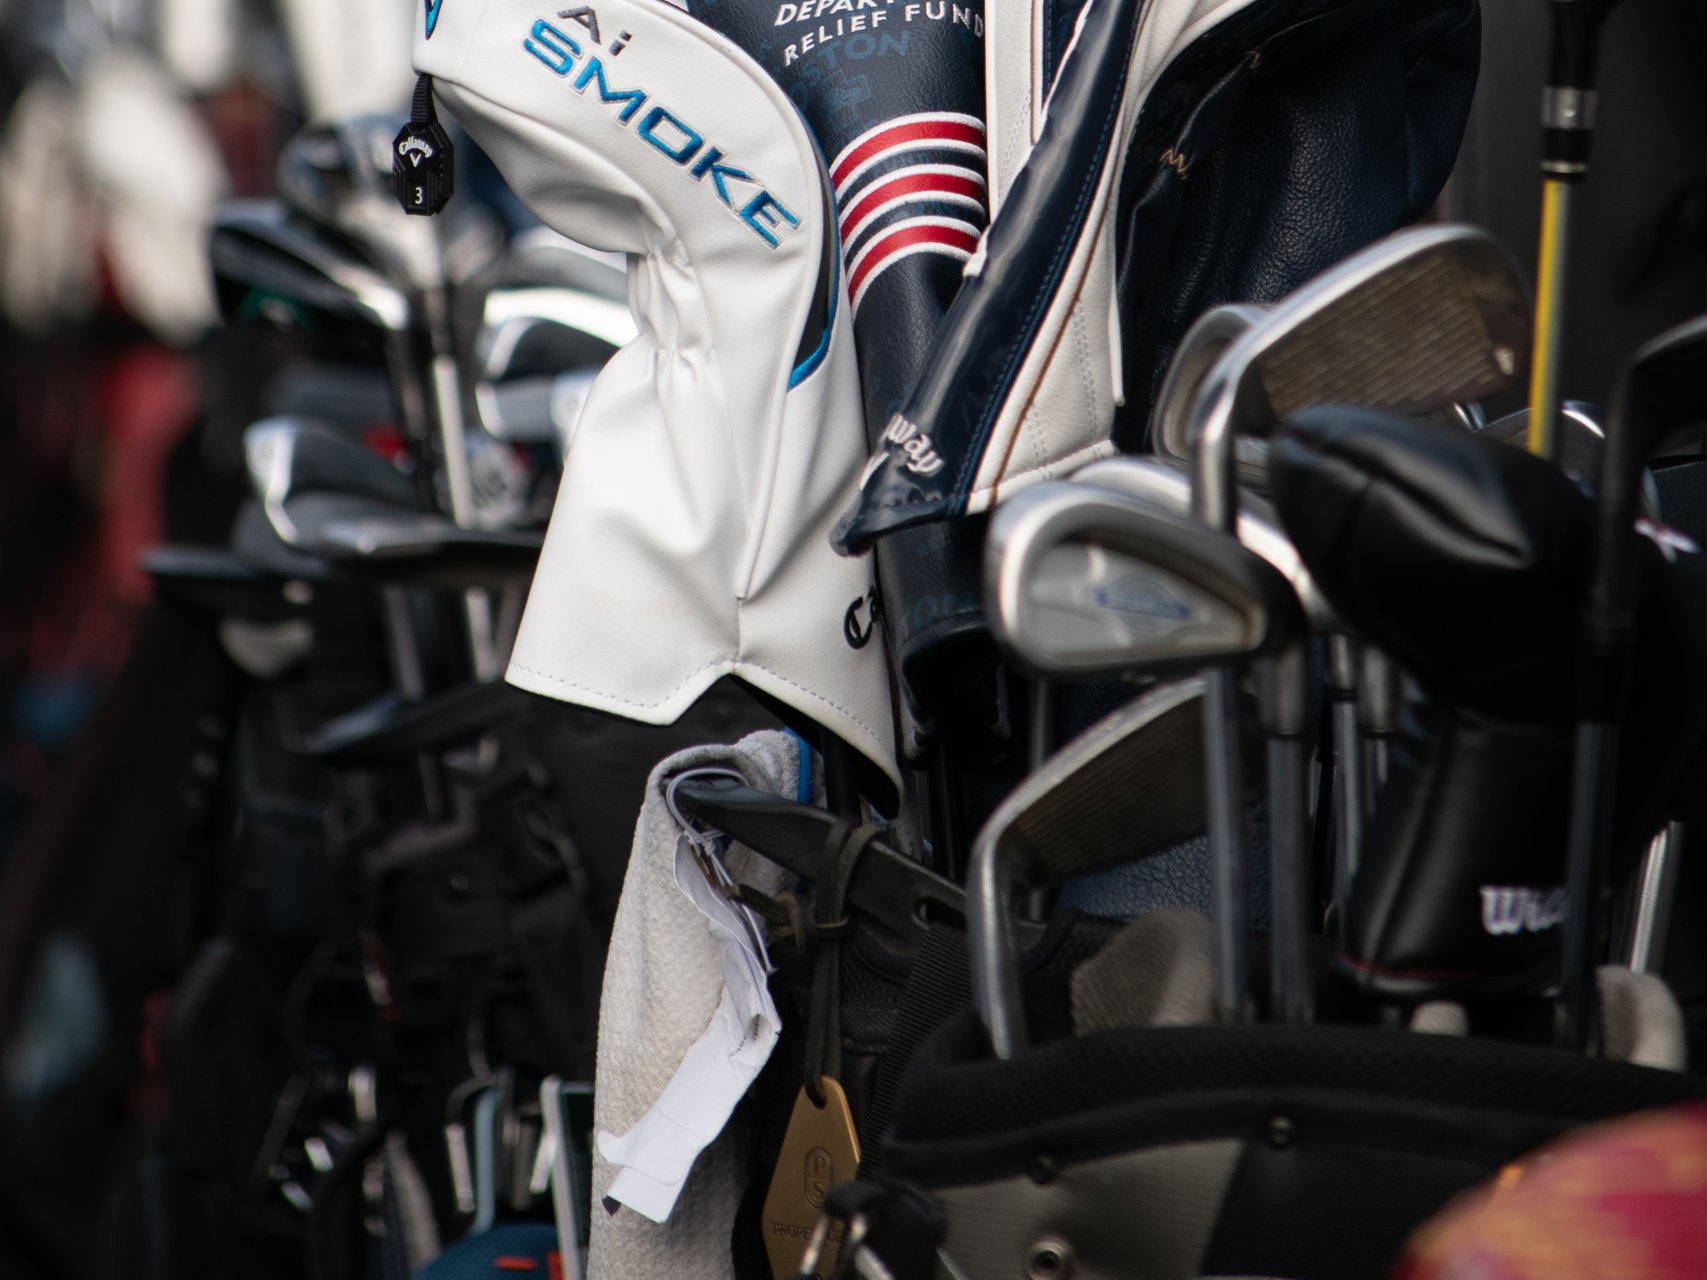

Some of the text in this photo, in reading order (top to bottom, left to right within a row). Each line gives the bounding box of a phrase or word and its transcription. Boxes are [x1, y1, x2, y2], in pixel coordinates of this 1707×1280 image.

[558, 4, 633, 57] Ai
[784, 0, 984, 68] RELIEF FUND
[398, 136, 434, 158] Callaway
[521, 15, 803, 251] SMOKE
[414, 186, 423, 205] 3
